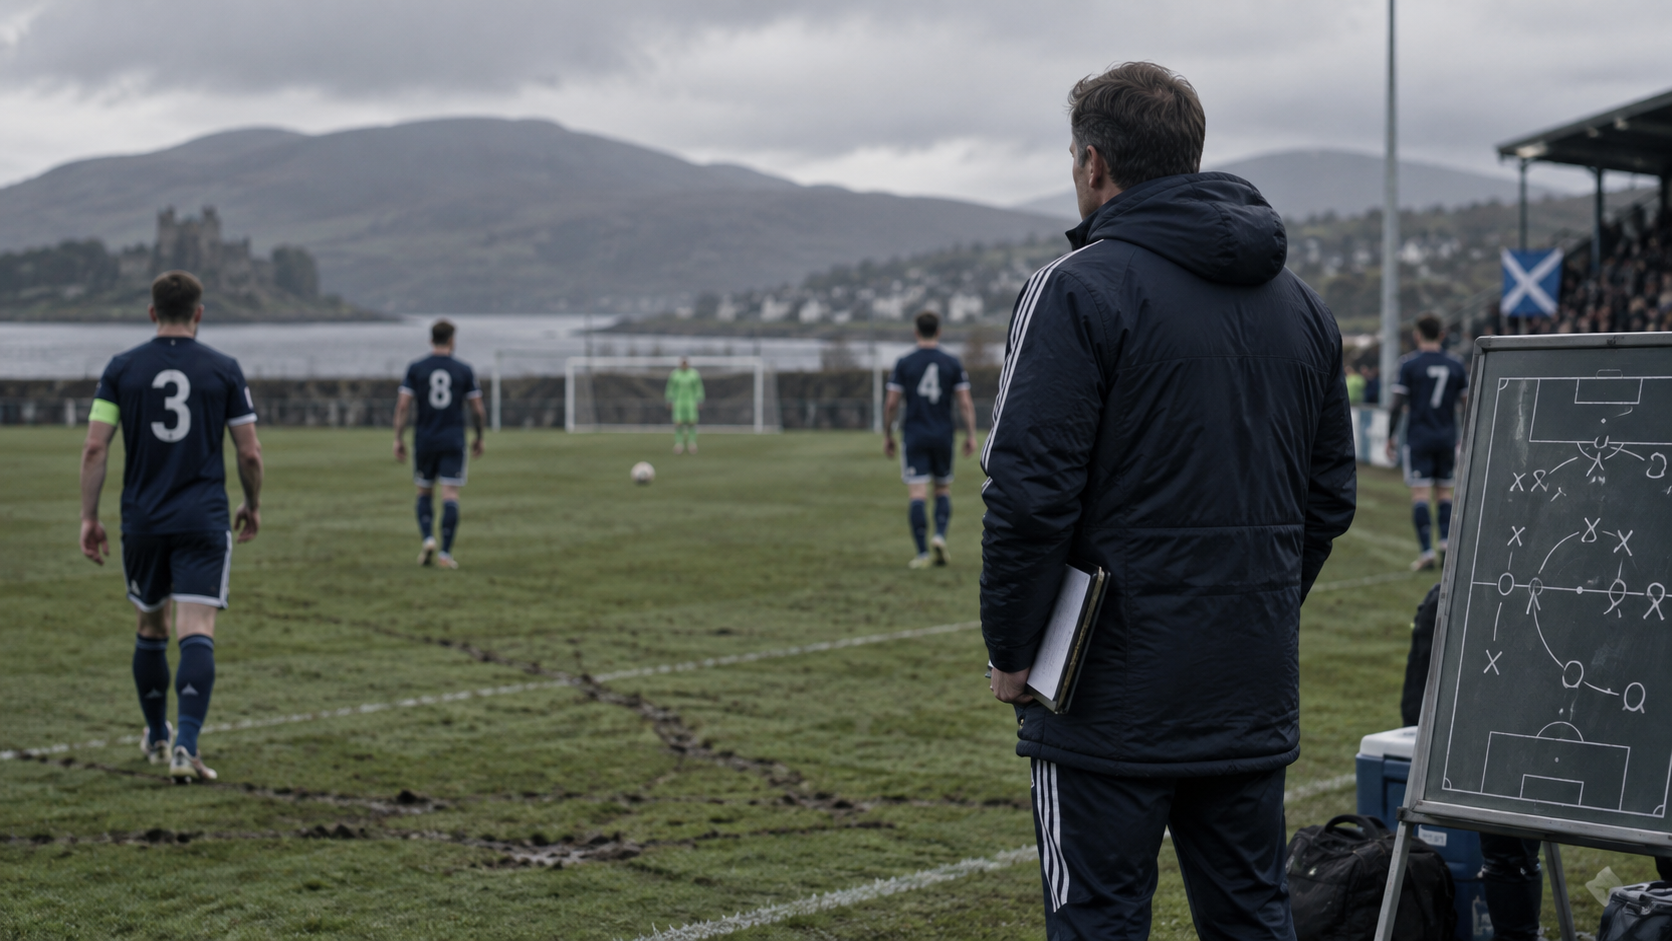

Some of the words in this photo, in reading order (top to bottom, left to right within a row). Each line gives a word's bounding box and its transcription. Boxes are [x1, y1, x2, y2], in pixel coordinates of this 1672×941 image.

[428, 369, 452, 409] 8
[917, 362, 942, 404] 4
[1427, 365, 1450, 408] 7
[151, 369, 191, 442] 3
